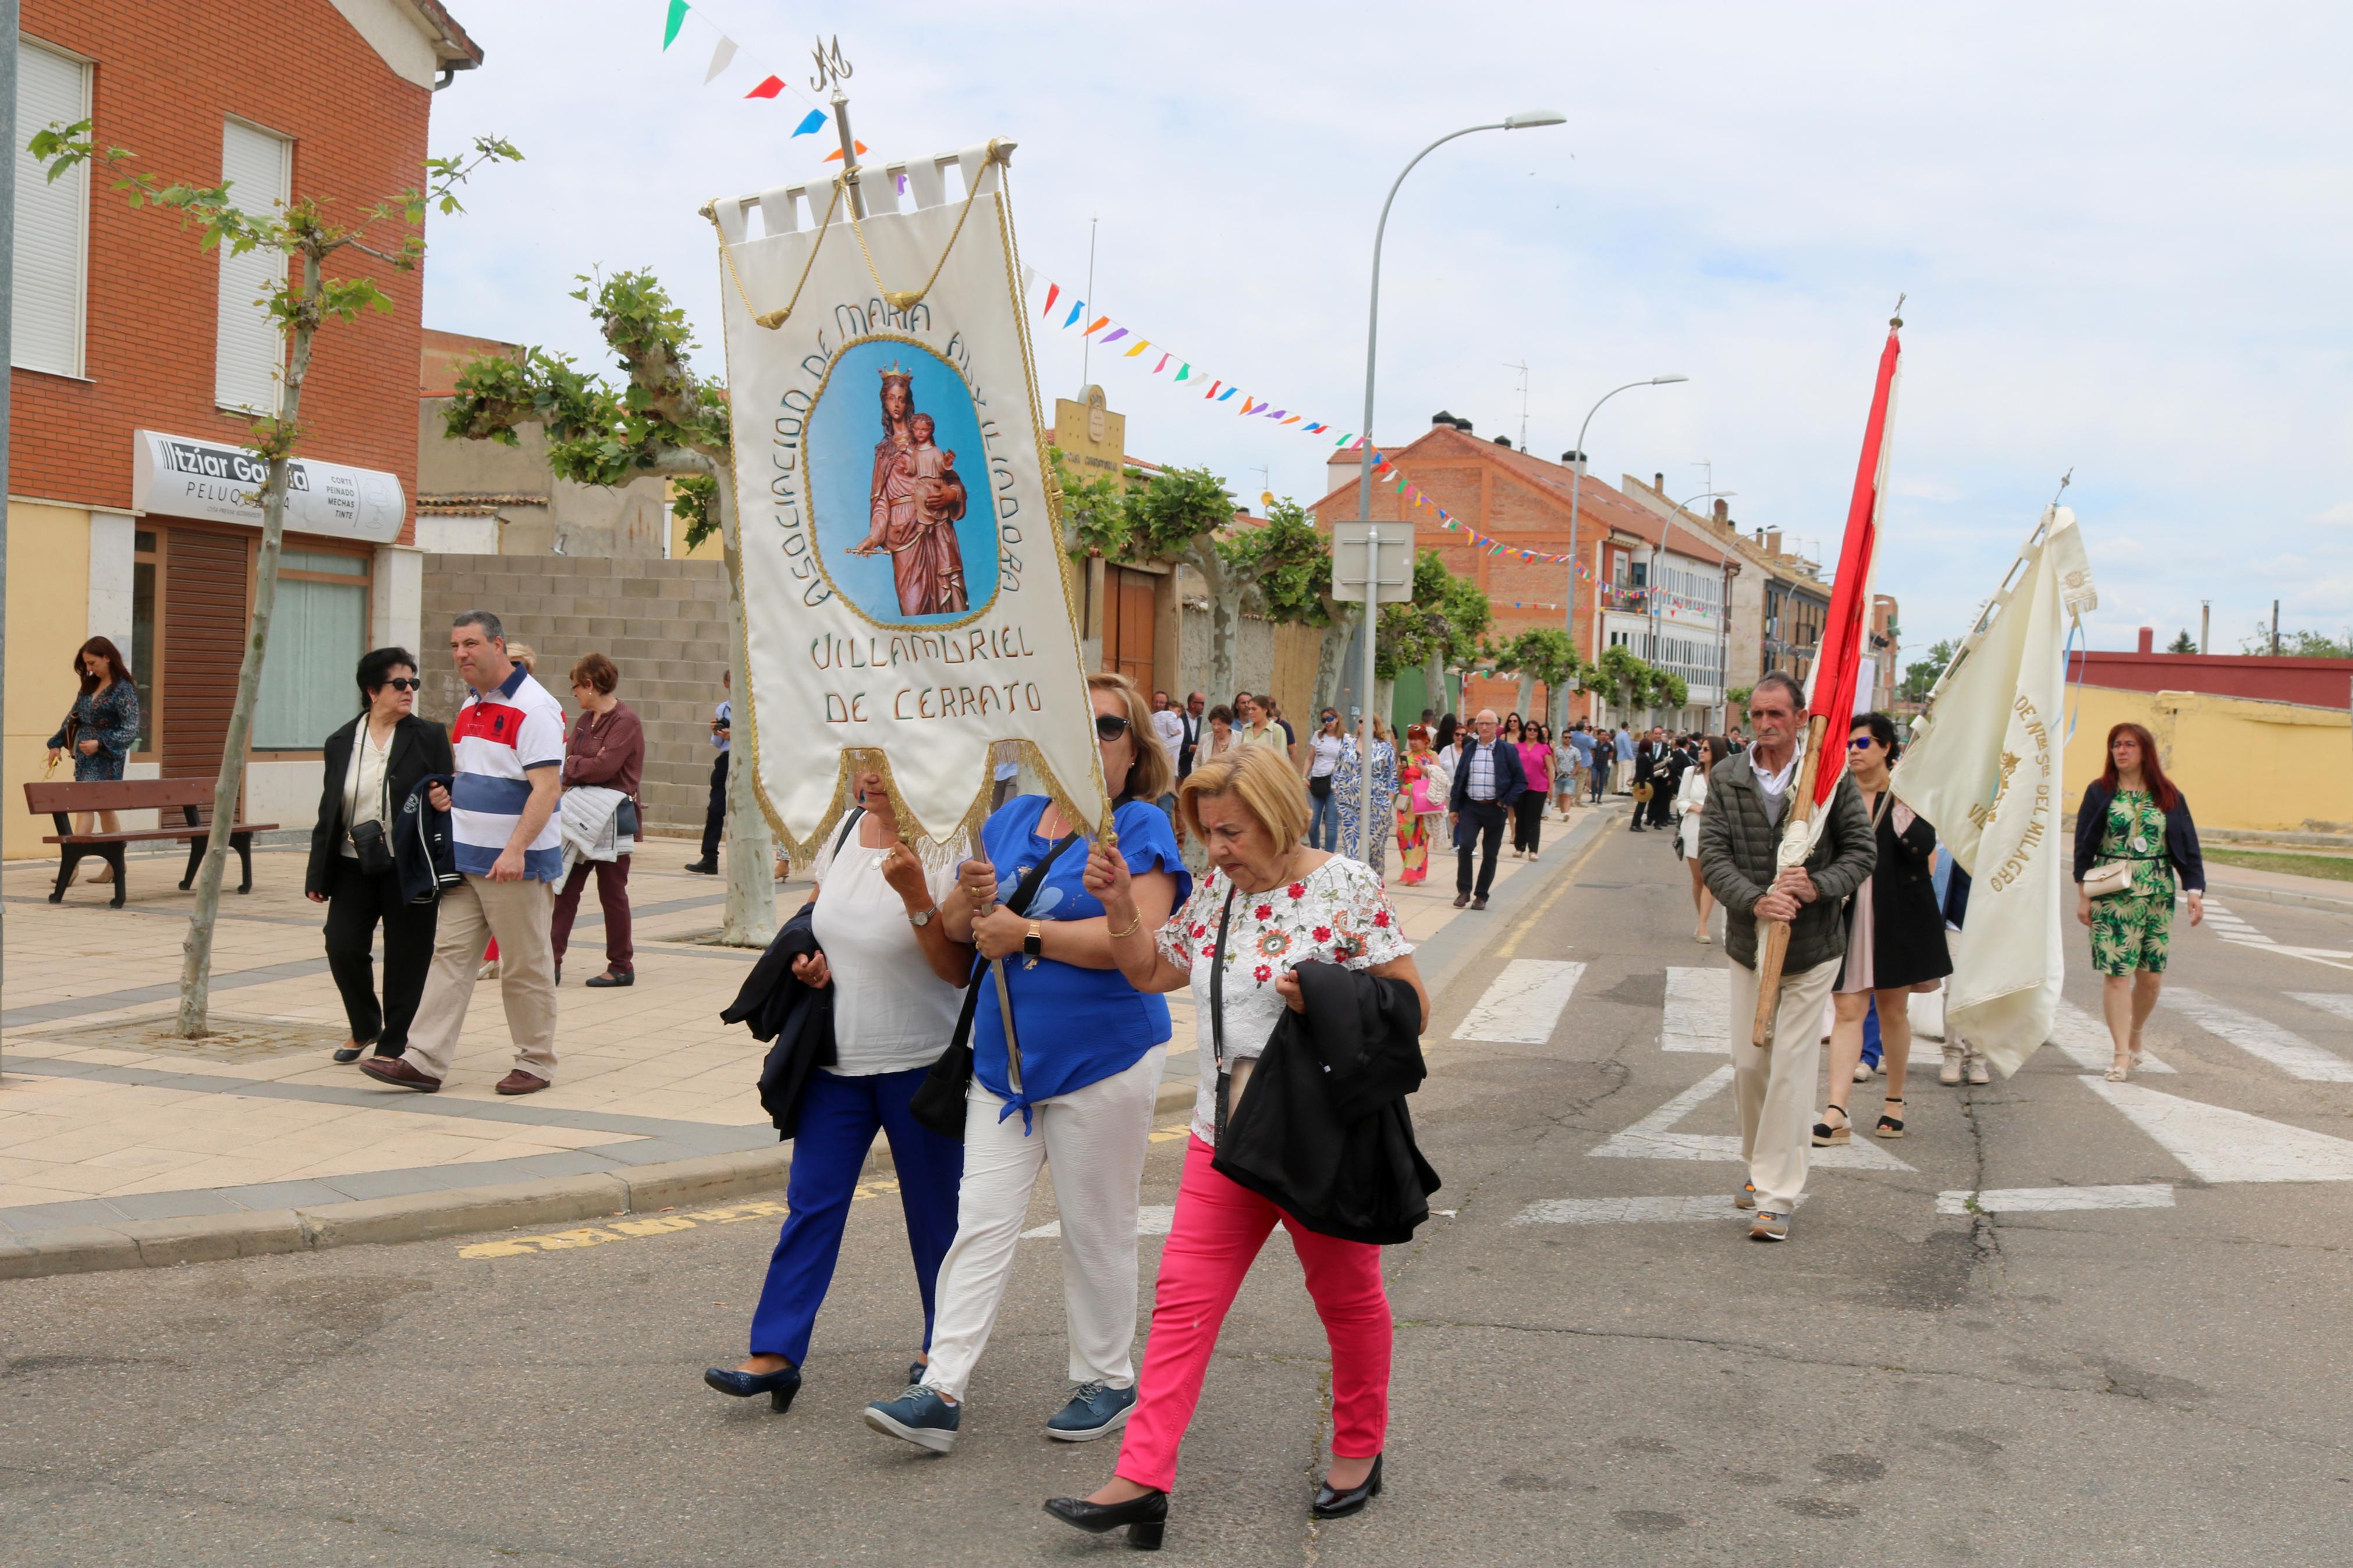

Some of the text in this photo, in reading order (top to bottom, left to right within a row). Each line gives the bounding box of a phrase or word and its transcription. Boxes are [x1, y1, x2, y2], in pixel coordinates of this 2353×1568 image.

[835, 297, 931, 342] MARIA
[801, 327, 832, 380] DE
[326, 485, 354, 497] PEINADO
[331, 476, 353, 486] CORTE
[772, 389, 832, 607] ASOCIACION
[328, 497, 354, 508] MECHAS
[335, 510, 353, 519] TINTE
[810, 625, 1034, 670] VILLAMURIEL
[825, 680, 1041, 723] DE CERRATO
[2014, 694, 2037, 721] DE
[2033, 785, 2049, 816] DEL
[1990, 820, 2046, 893] MILAGRO
